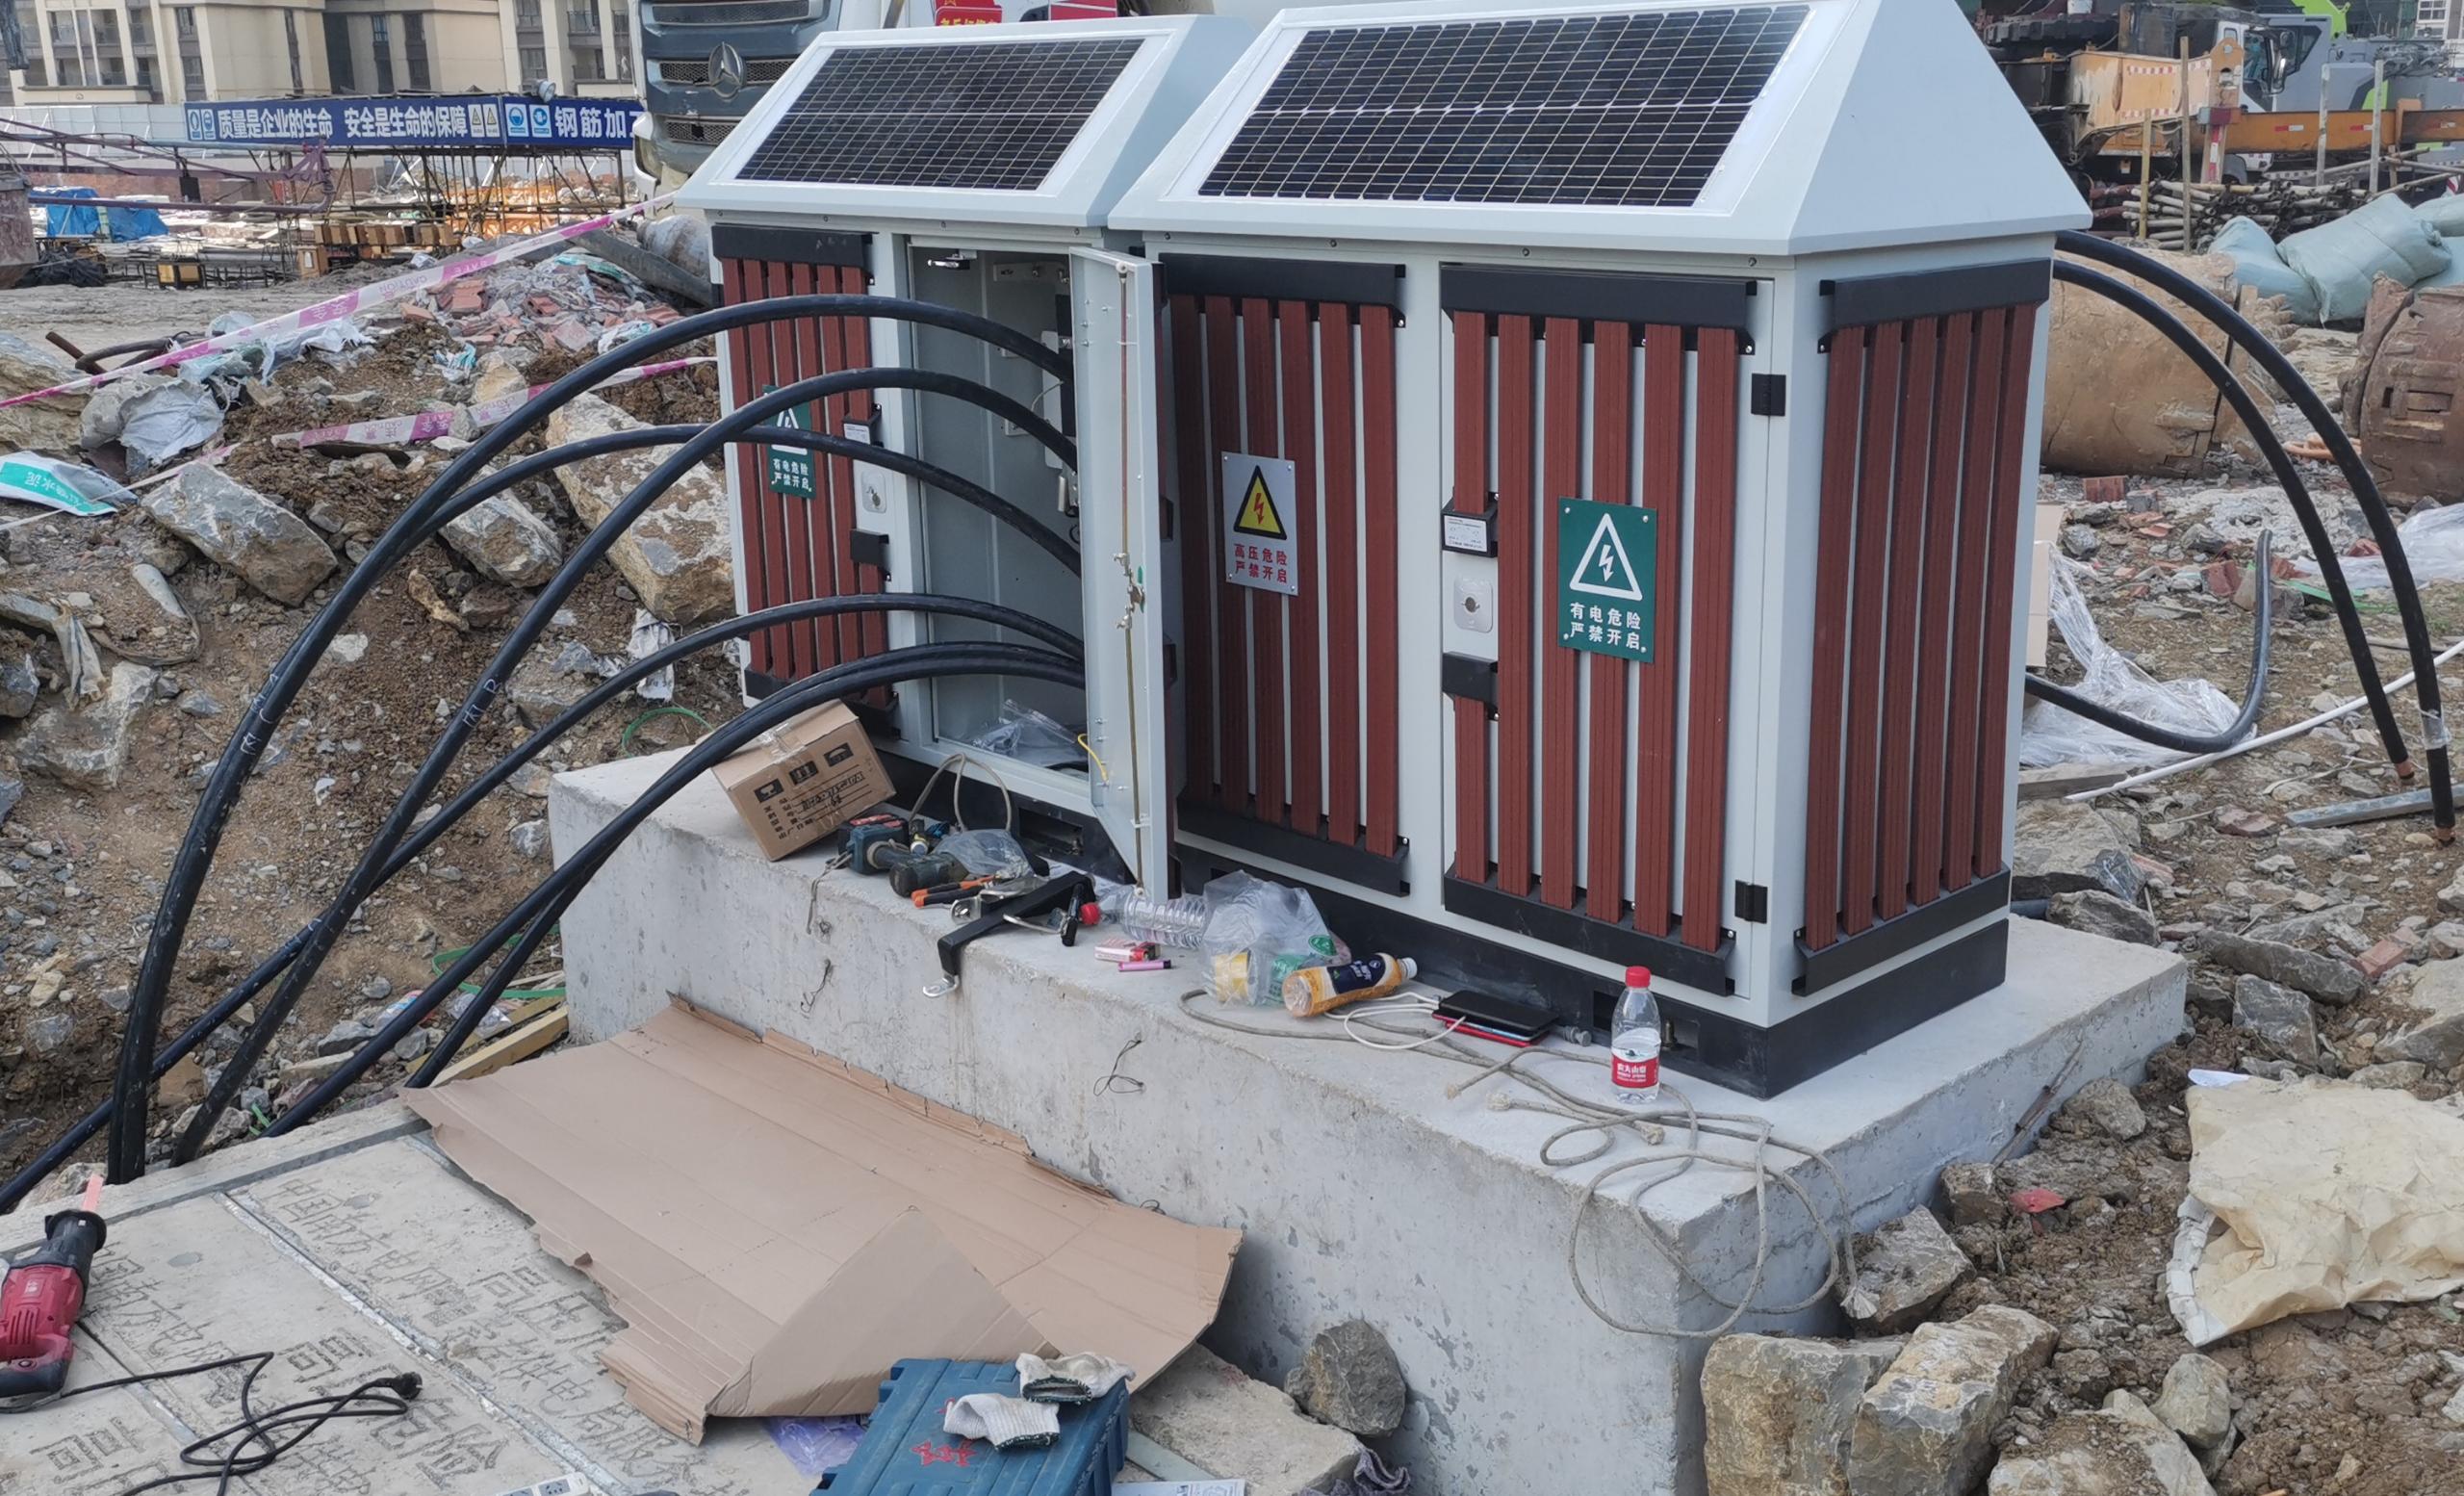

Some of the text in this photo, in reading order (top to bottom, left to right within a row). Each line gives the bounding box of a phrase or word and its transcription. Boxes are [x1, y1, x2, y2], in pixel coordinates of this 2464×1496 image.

[218, 105, 469, 140] 质量是企业的生命 安全是生命的保障
[773, 458, 809, 476] 有电危险
[773, 472, 809, 490] 严禁开启
[1234, 543, 1288, 566] 高压危险
[1235, 560, 1288, 583] 严禁开启
[1569, 602, 1641, 630] 有电危险
[1569, 622, 1640, 650] 严禁开启
